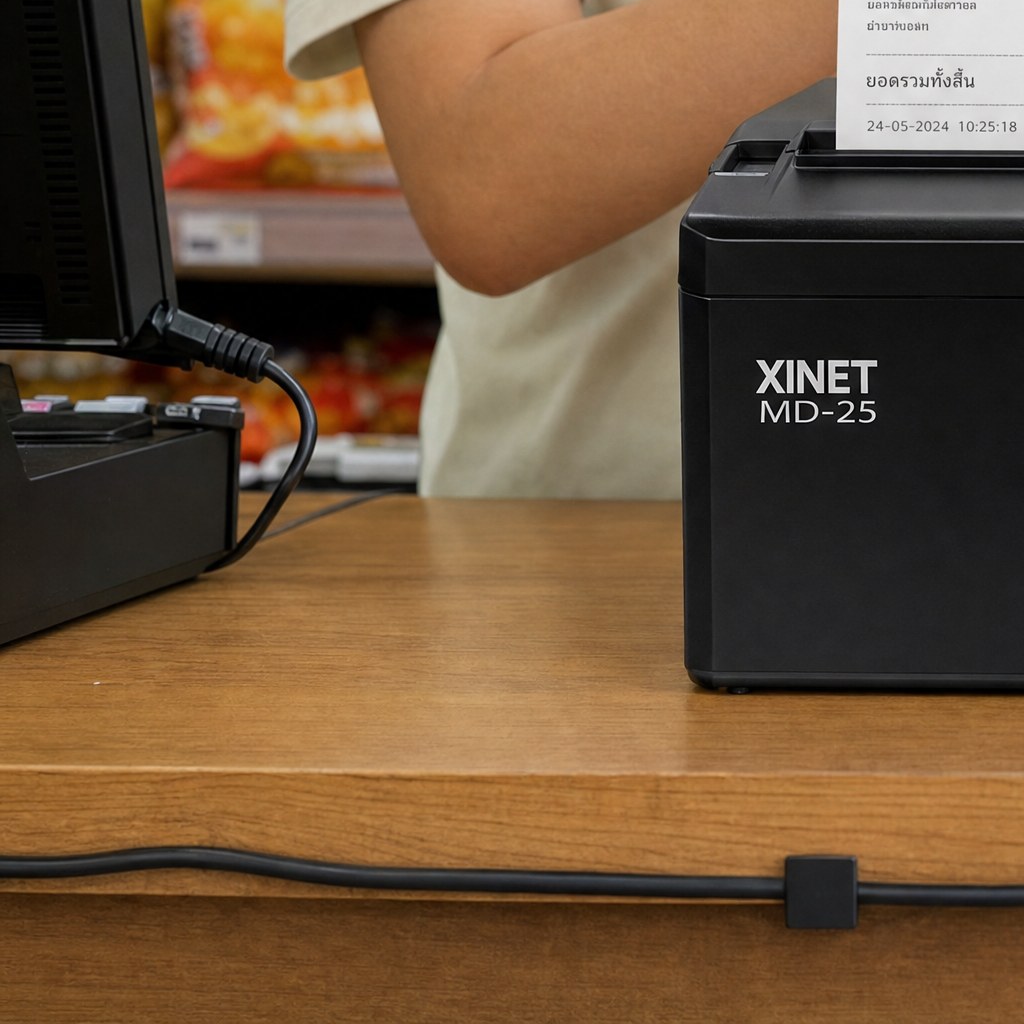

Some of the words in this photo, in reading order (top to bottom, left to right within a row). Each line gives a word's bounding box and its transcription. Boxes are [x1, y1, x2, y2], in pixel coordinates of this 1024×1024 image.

[866, 66, 975, 89] ยอดรวมทั้งสิ้น
[866, 119, 949, 133] 24-05-2024
[958, 120, 1017, 133] 10:25:18
[756, 360, 877, 393] XINET
[761, 401, 876, 423] MD-25
